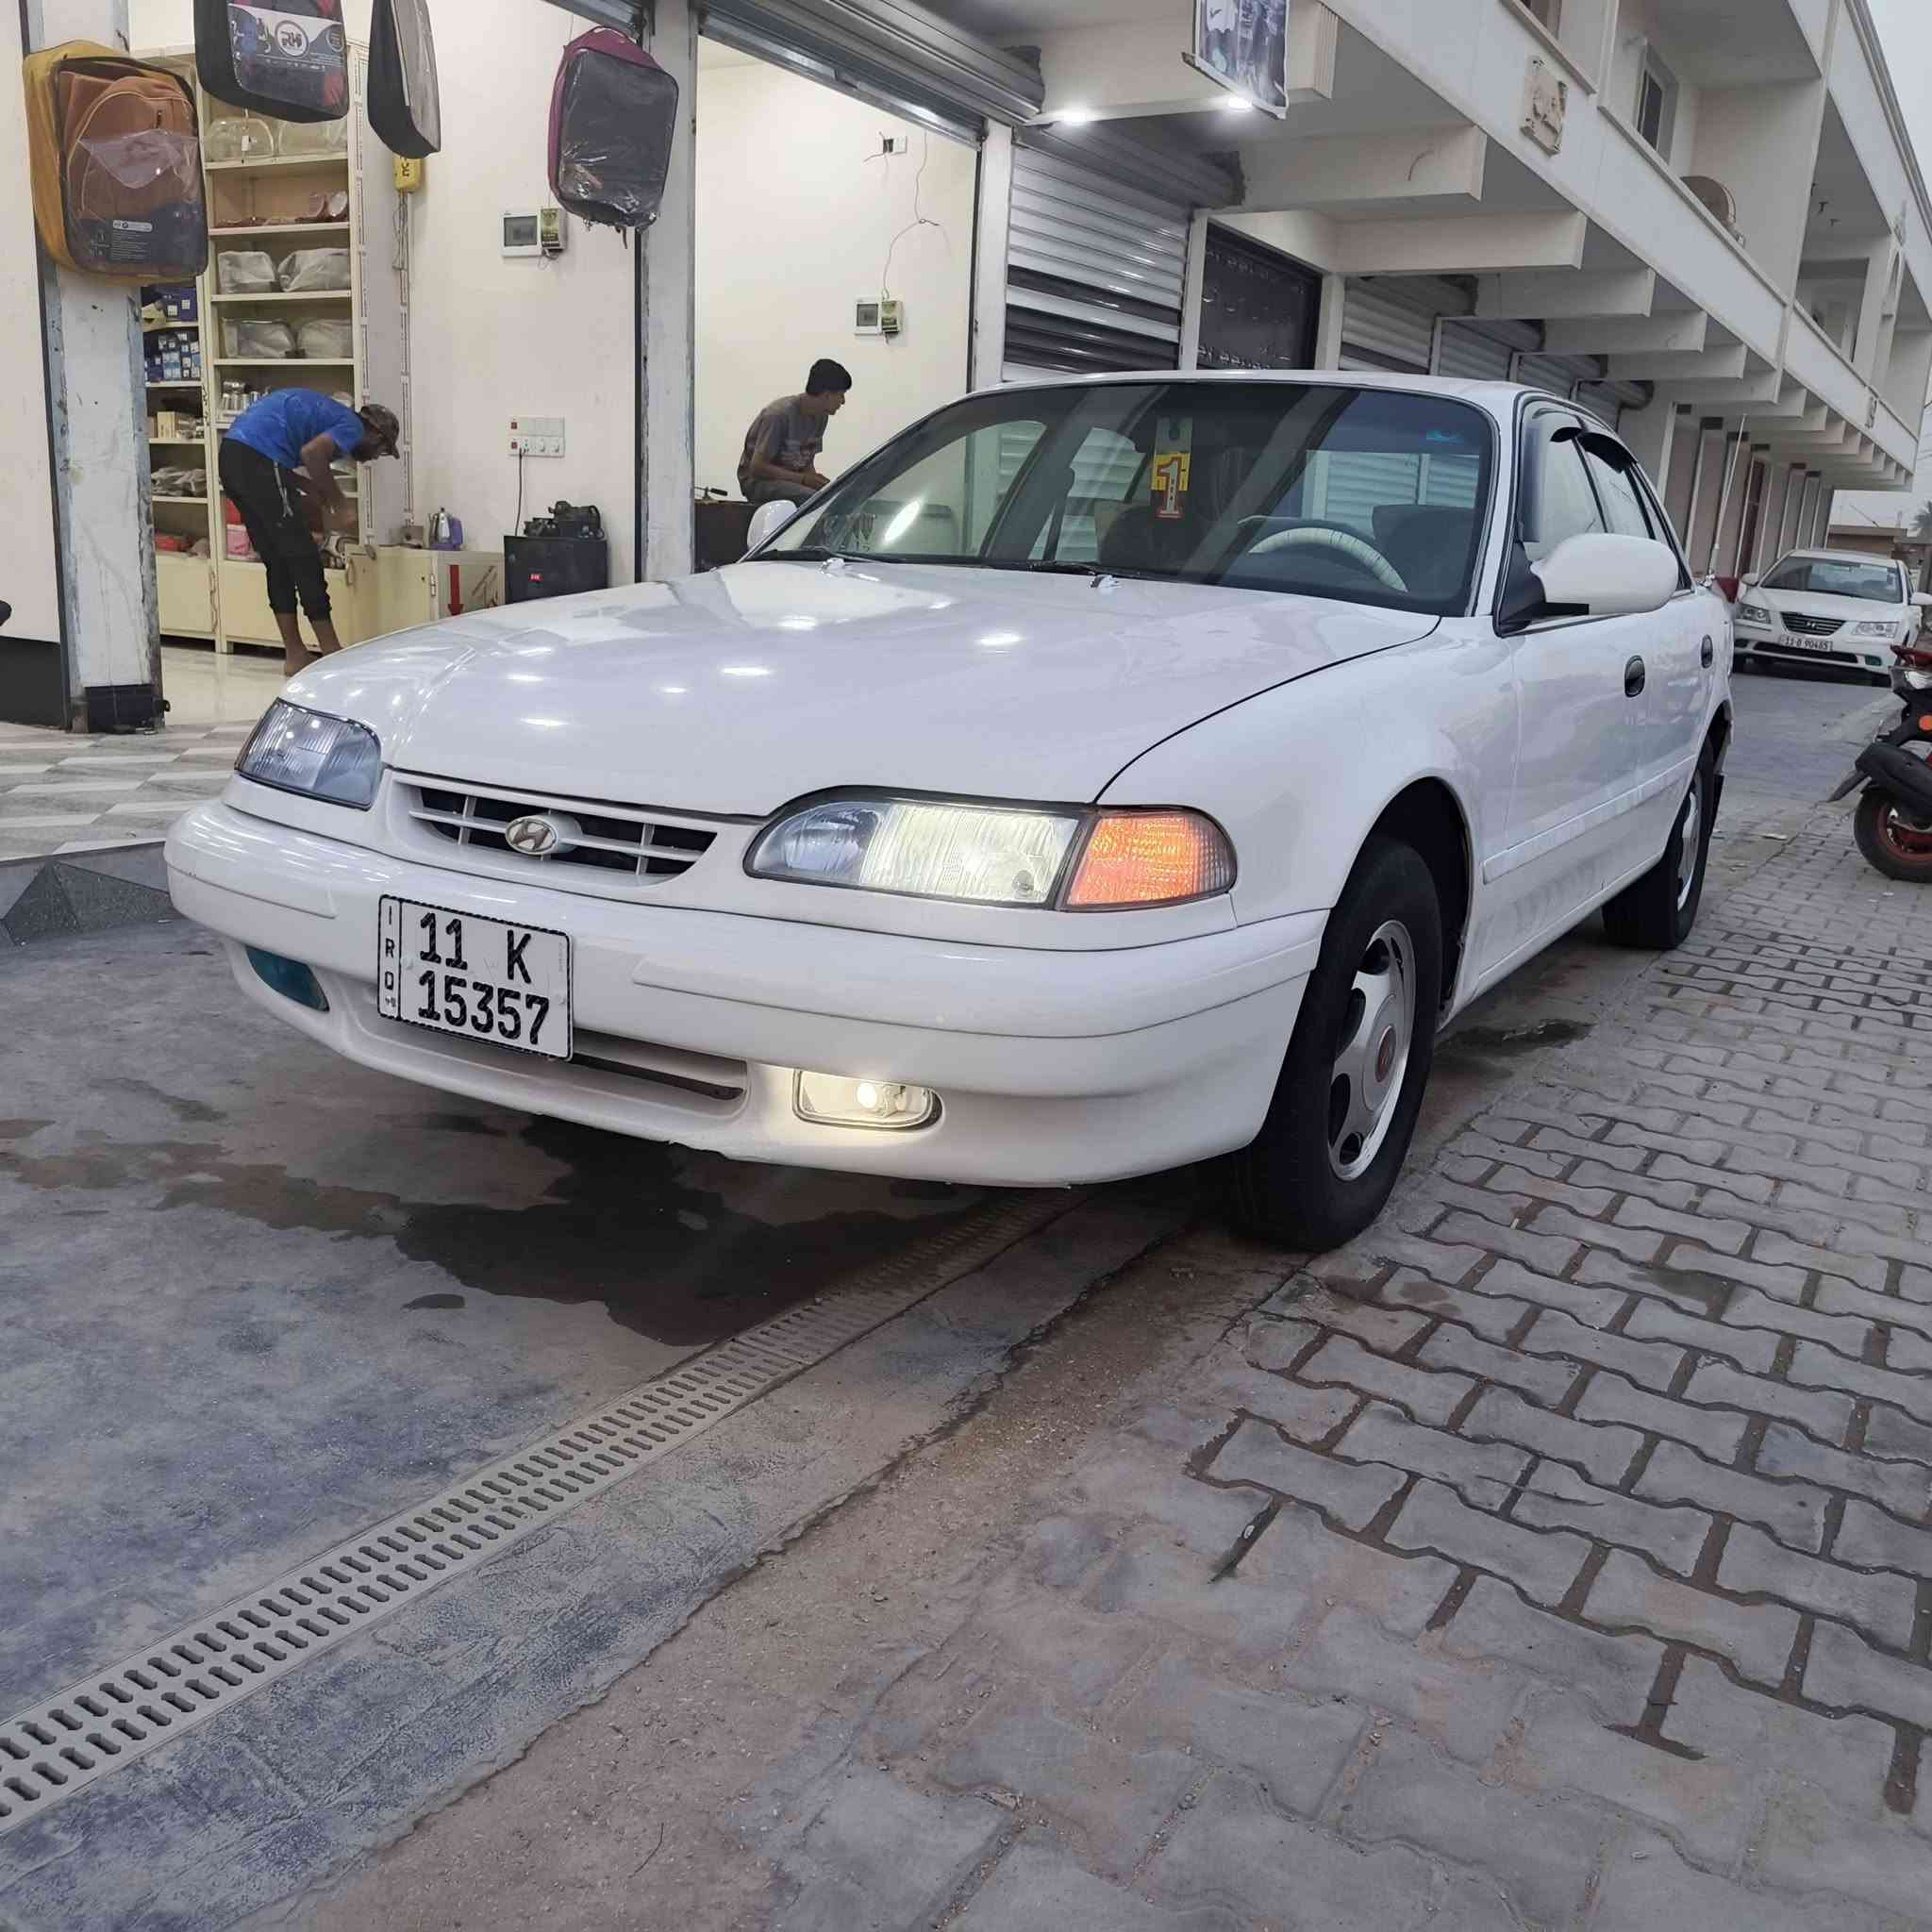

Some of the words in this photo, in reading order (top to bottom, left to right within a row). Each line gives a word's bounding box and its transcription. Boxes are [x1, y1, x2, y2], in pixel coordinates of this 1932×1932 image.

[420, 912, 468, 970] 11
[507, 929, 532, 984] K
[418, 970, 550, 1045] 15357
